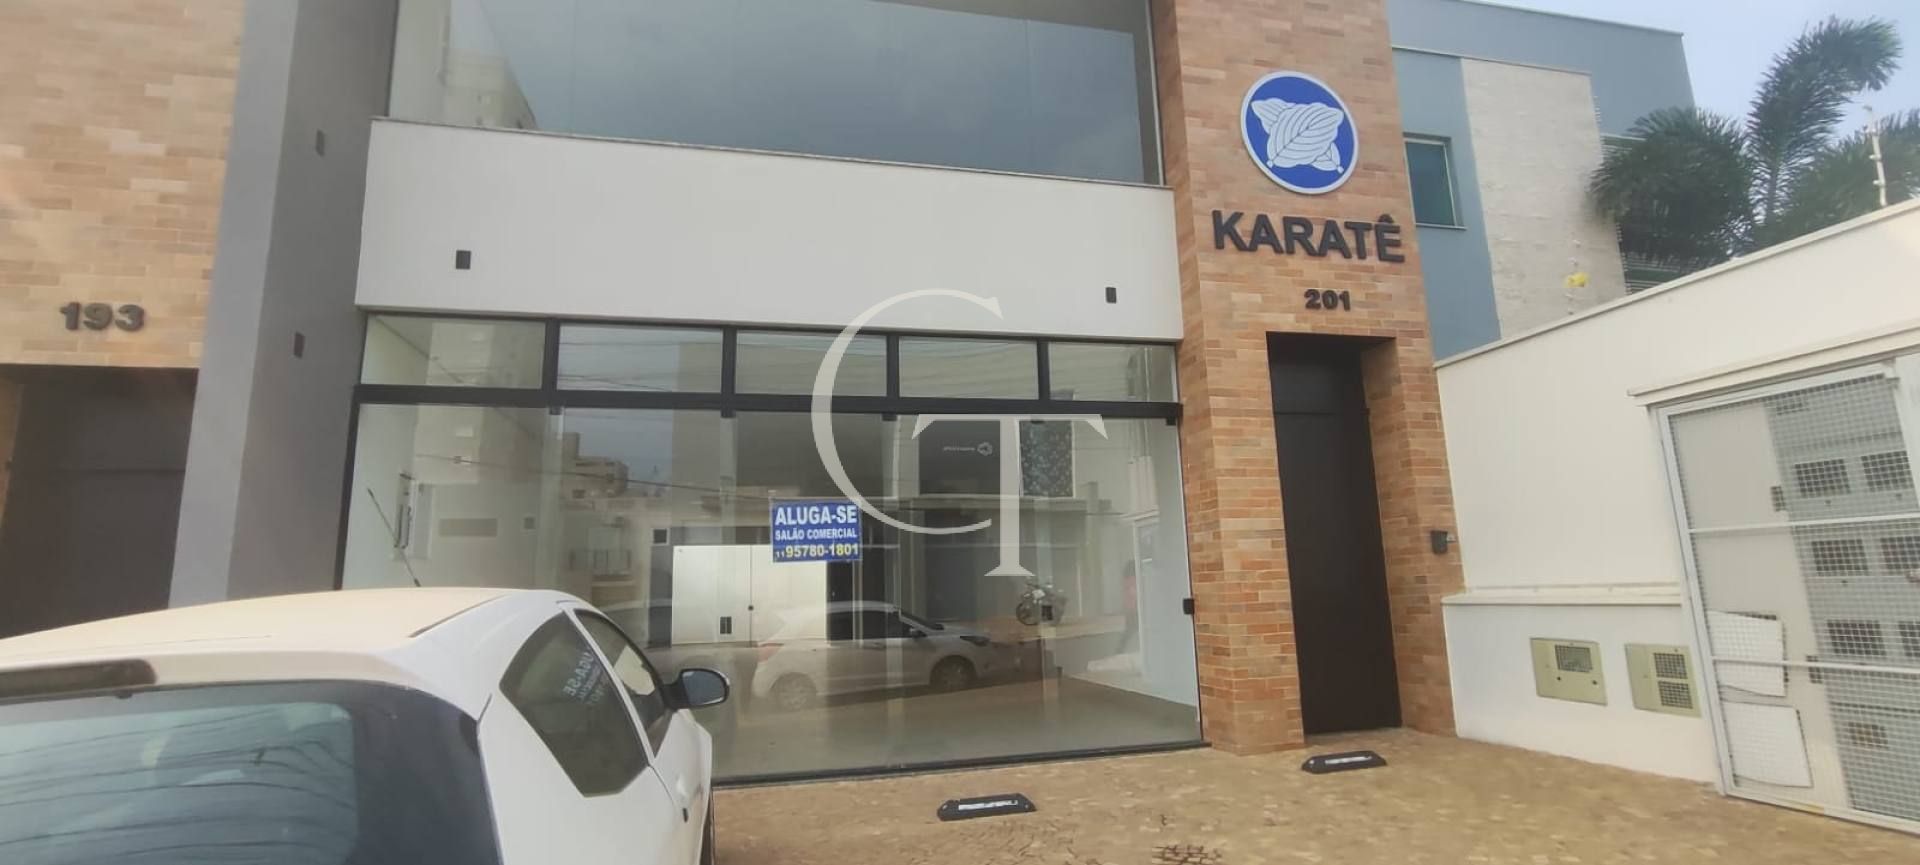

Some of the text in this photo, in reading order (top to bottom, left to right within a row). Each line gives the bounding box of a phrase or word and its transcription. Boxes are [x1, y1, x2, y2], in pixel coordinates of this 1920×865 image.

[1212, 209, 1404, 263] KARATÊ
[1304, 288, 1351, 311] 201
[59, 301, 145, 332] 193
[774, 505, 858, 526] ALUGA-SE
[775, 527, 858, 541] SALÃO COMERCIAL
